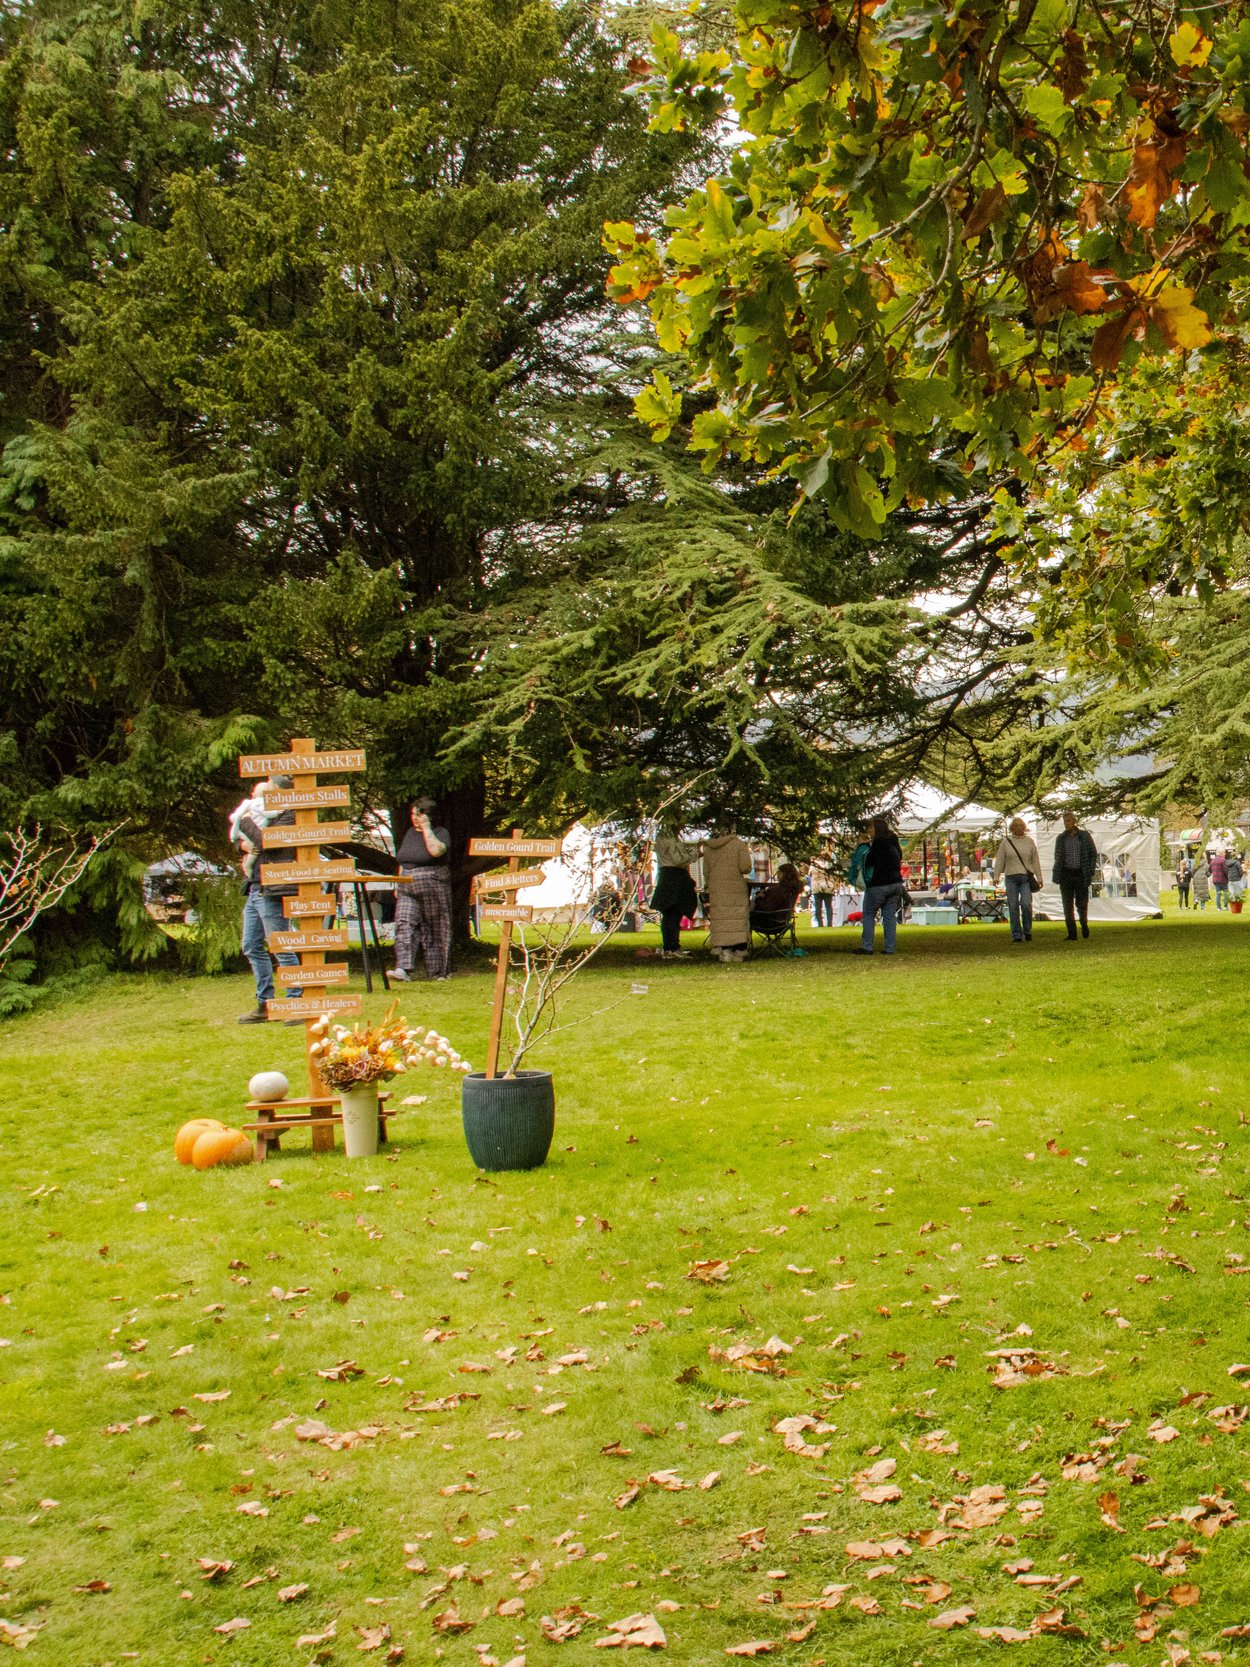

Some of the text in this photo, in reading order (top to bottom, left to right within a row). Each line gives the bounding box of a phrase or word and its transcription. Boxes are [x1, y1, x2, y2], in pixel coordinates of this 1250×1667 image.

[242, 754, 364, 773] AUTUMN MARKET
[265, 790, 347, 803] Fabulous Stalls
[264, 827, 351, 840] Golden Gourd Trail
[475, 841, 556, 852] Golden Gourd Trail
[266, 866, 353, 878] Street Food & Seating
[485, 876, 504, 888] Find
[512, 874, 538, 884] letters
[290, 900, 331, 911] Play Tent
[486, 908, 529, 917] unscramble
[277, 933, 343, 945] Wood Carving
[281, 968, 347, 980] Garden Games
[270, 1001, 309, 1011] Psychics
[323, 999, 357, 1008] Healers
